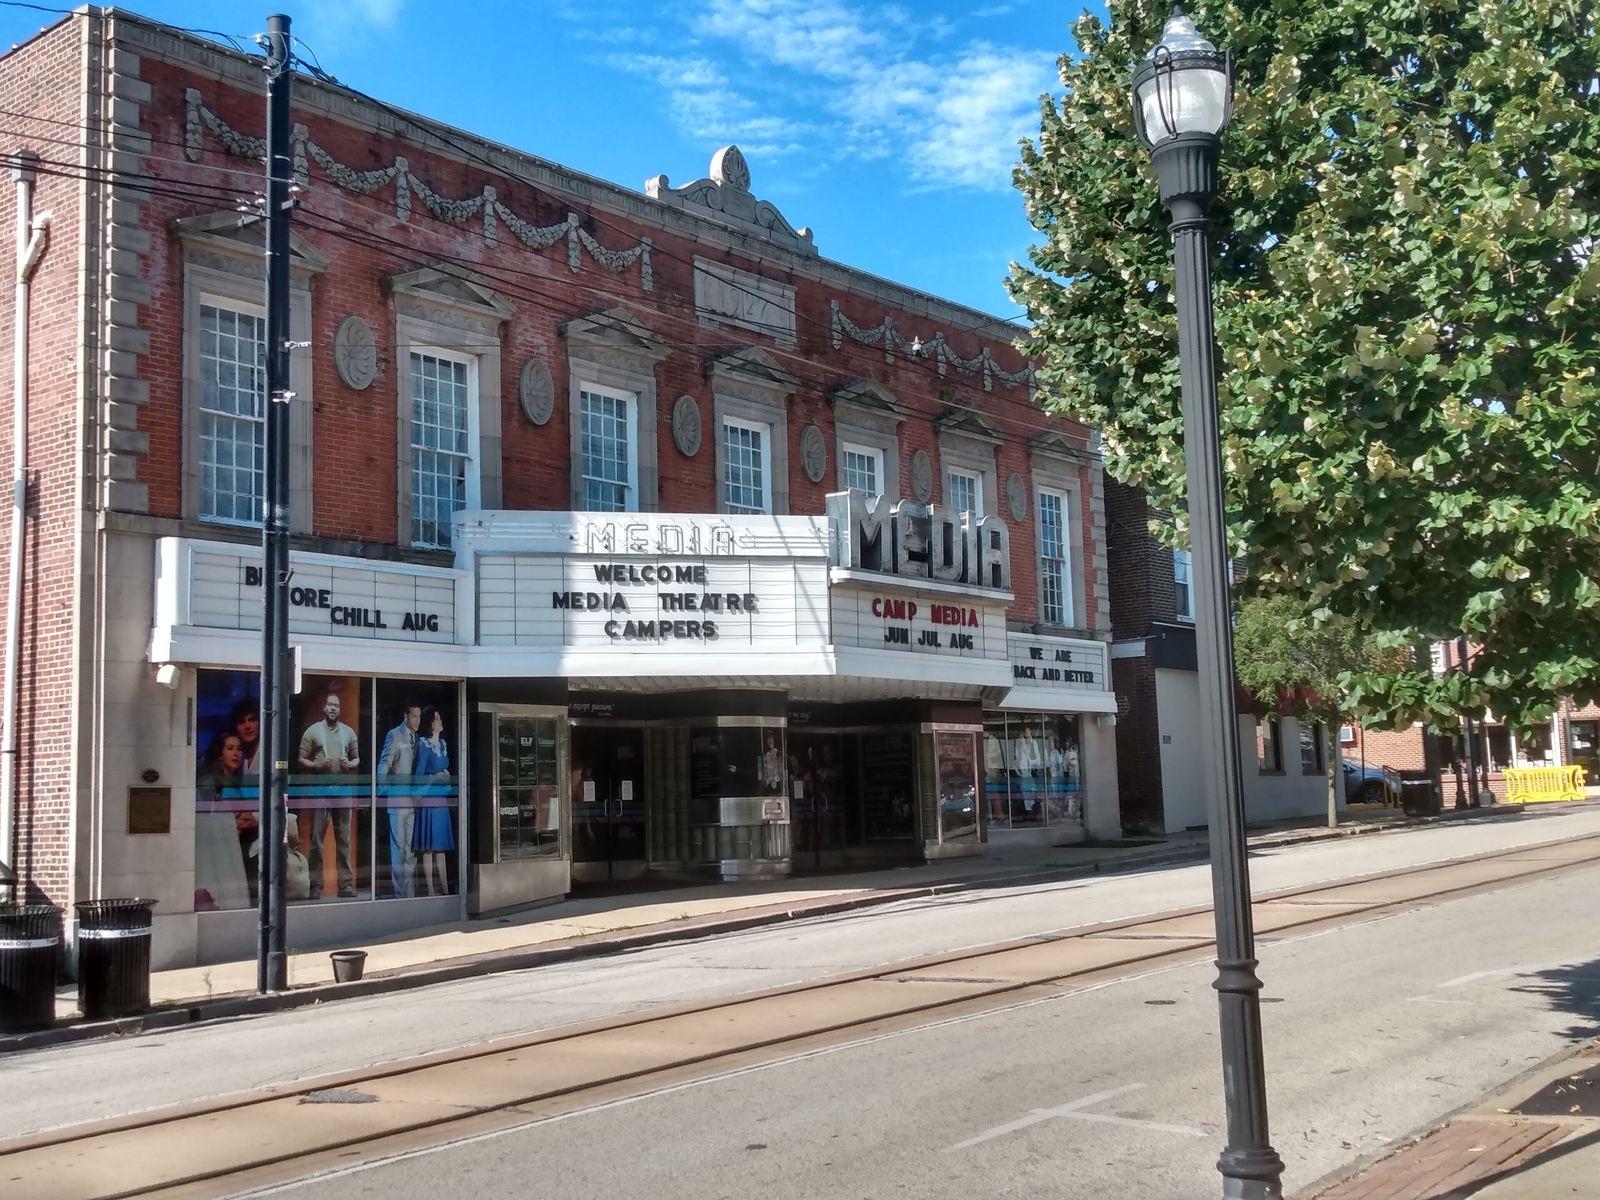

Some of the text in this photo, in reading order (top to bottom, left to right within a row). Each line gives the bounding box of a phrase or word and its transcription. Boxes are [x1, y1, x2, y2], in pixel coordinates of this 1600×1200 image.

[582, 518, 735, 555] MEDIA
[849, 488, 1012, 590] MEDIA
[593, 564, 706, 583] WELCOME
[552, 591, 756, 612] MEDIA THEATRE
[872, 597, 979, 628] CAMP MEDIA
[330, 605, 439, 633] CHILL AUG
[604, 619, 717, 638] CAMPERS
[883, 626, 974, 650] JUN JUL AUG
[1029, 646, 1073, 663] WE ARE
[1013, 664, 1095, 684] BACK AND BETTER
